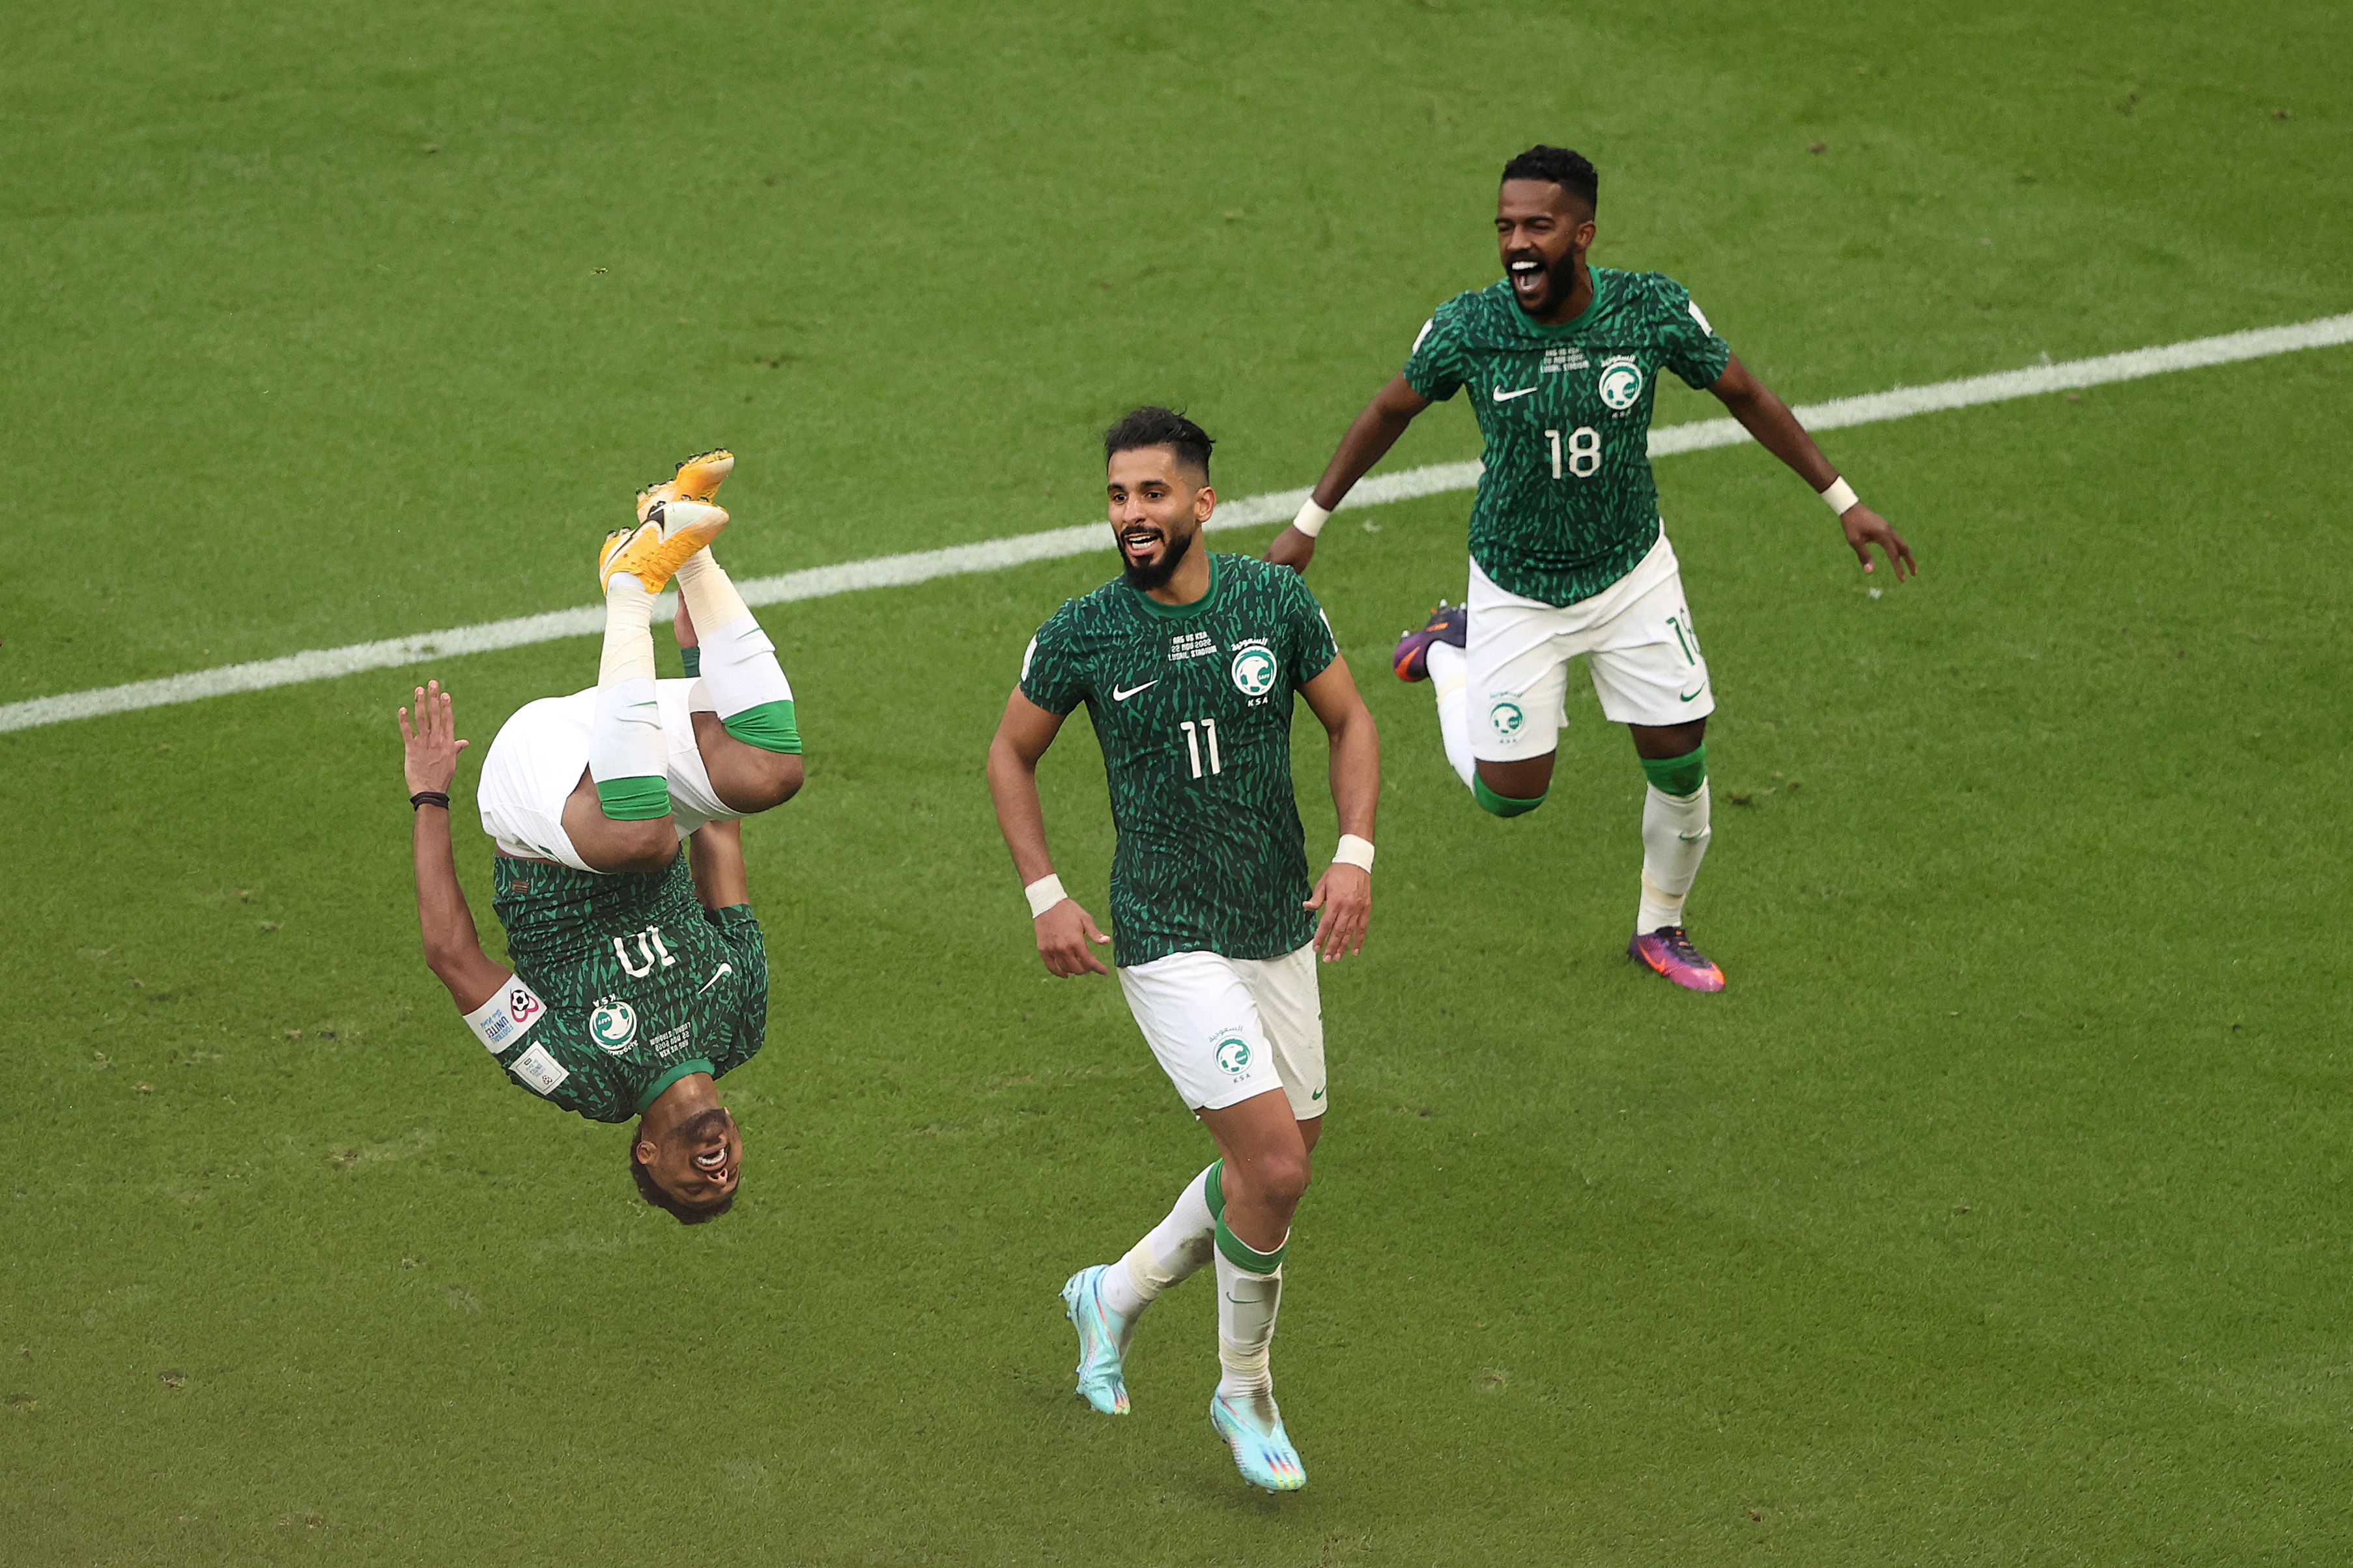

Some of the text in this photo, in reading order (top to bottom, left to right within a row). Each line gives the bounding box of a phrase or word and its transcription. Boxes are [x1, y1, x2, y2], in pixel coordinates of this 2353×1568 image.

[1545, 425, 1601, 479] 18
[1173, 631, 1208, 644] ARG VS KSA
[1181, 642, 1194, 651] NOV
[1195, 638, 1212, 648] 2022
[1167, 645, 1218, 661] LUSAIL STADIUM
[1248, 696, 1268, 707] KSA
[1180, 719, 1221, 778] 11
[614, 924, 676, 978] 10
[593, 993, 616, 1008] KSA
[649, 1021, 691, 1046] LUSAIL STADIUM
[655, 1031, 690, 1052] 22 NOV 2022
[659, 1039, 689, 1058] ARG VS KSA
